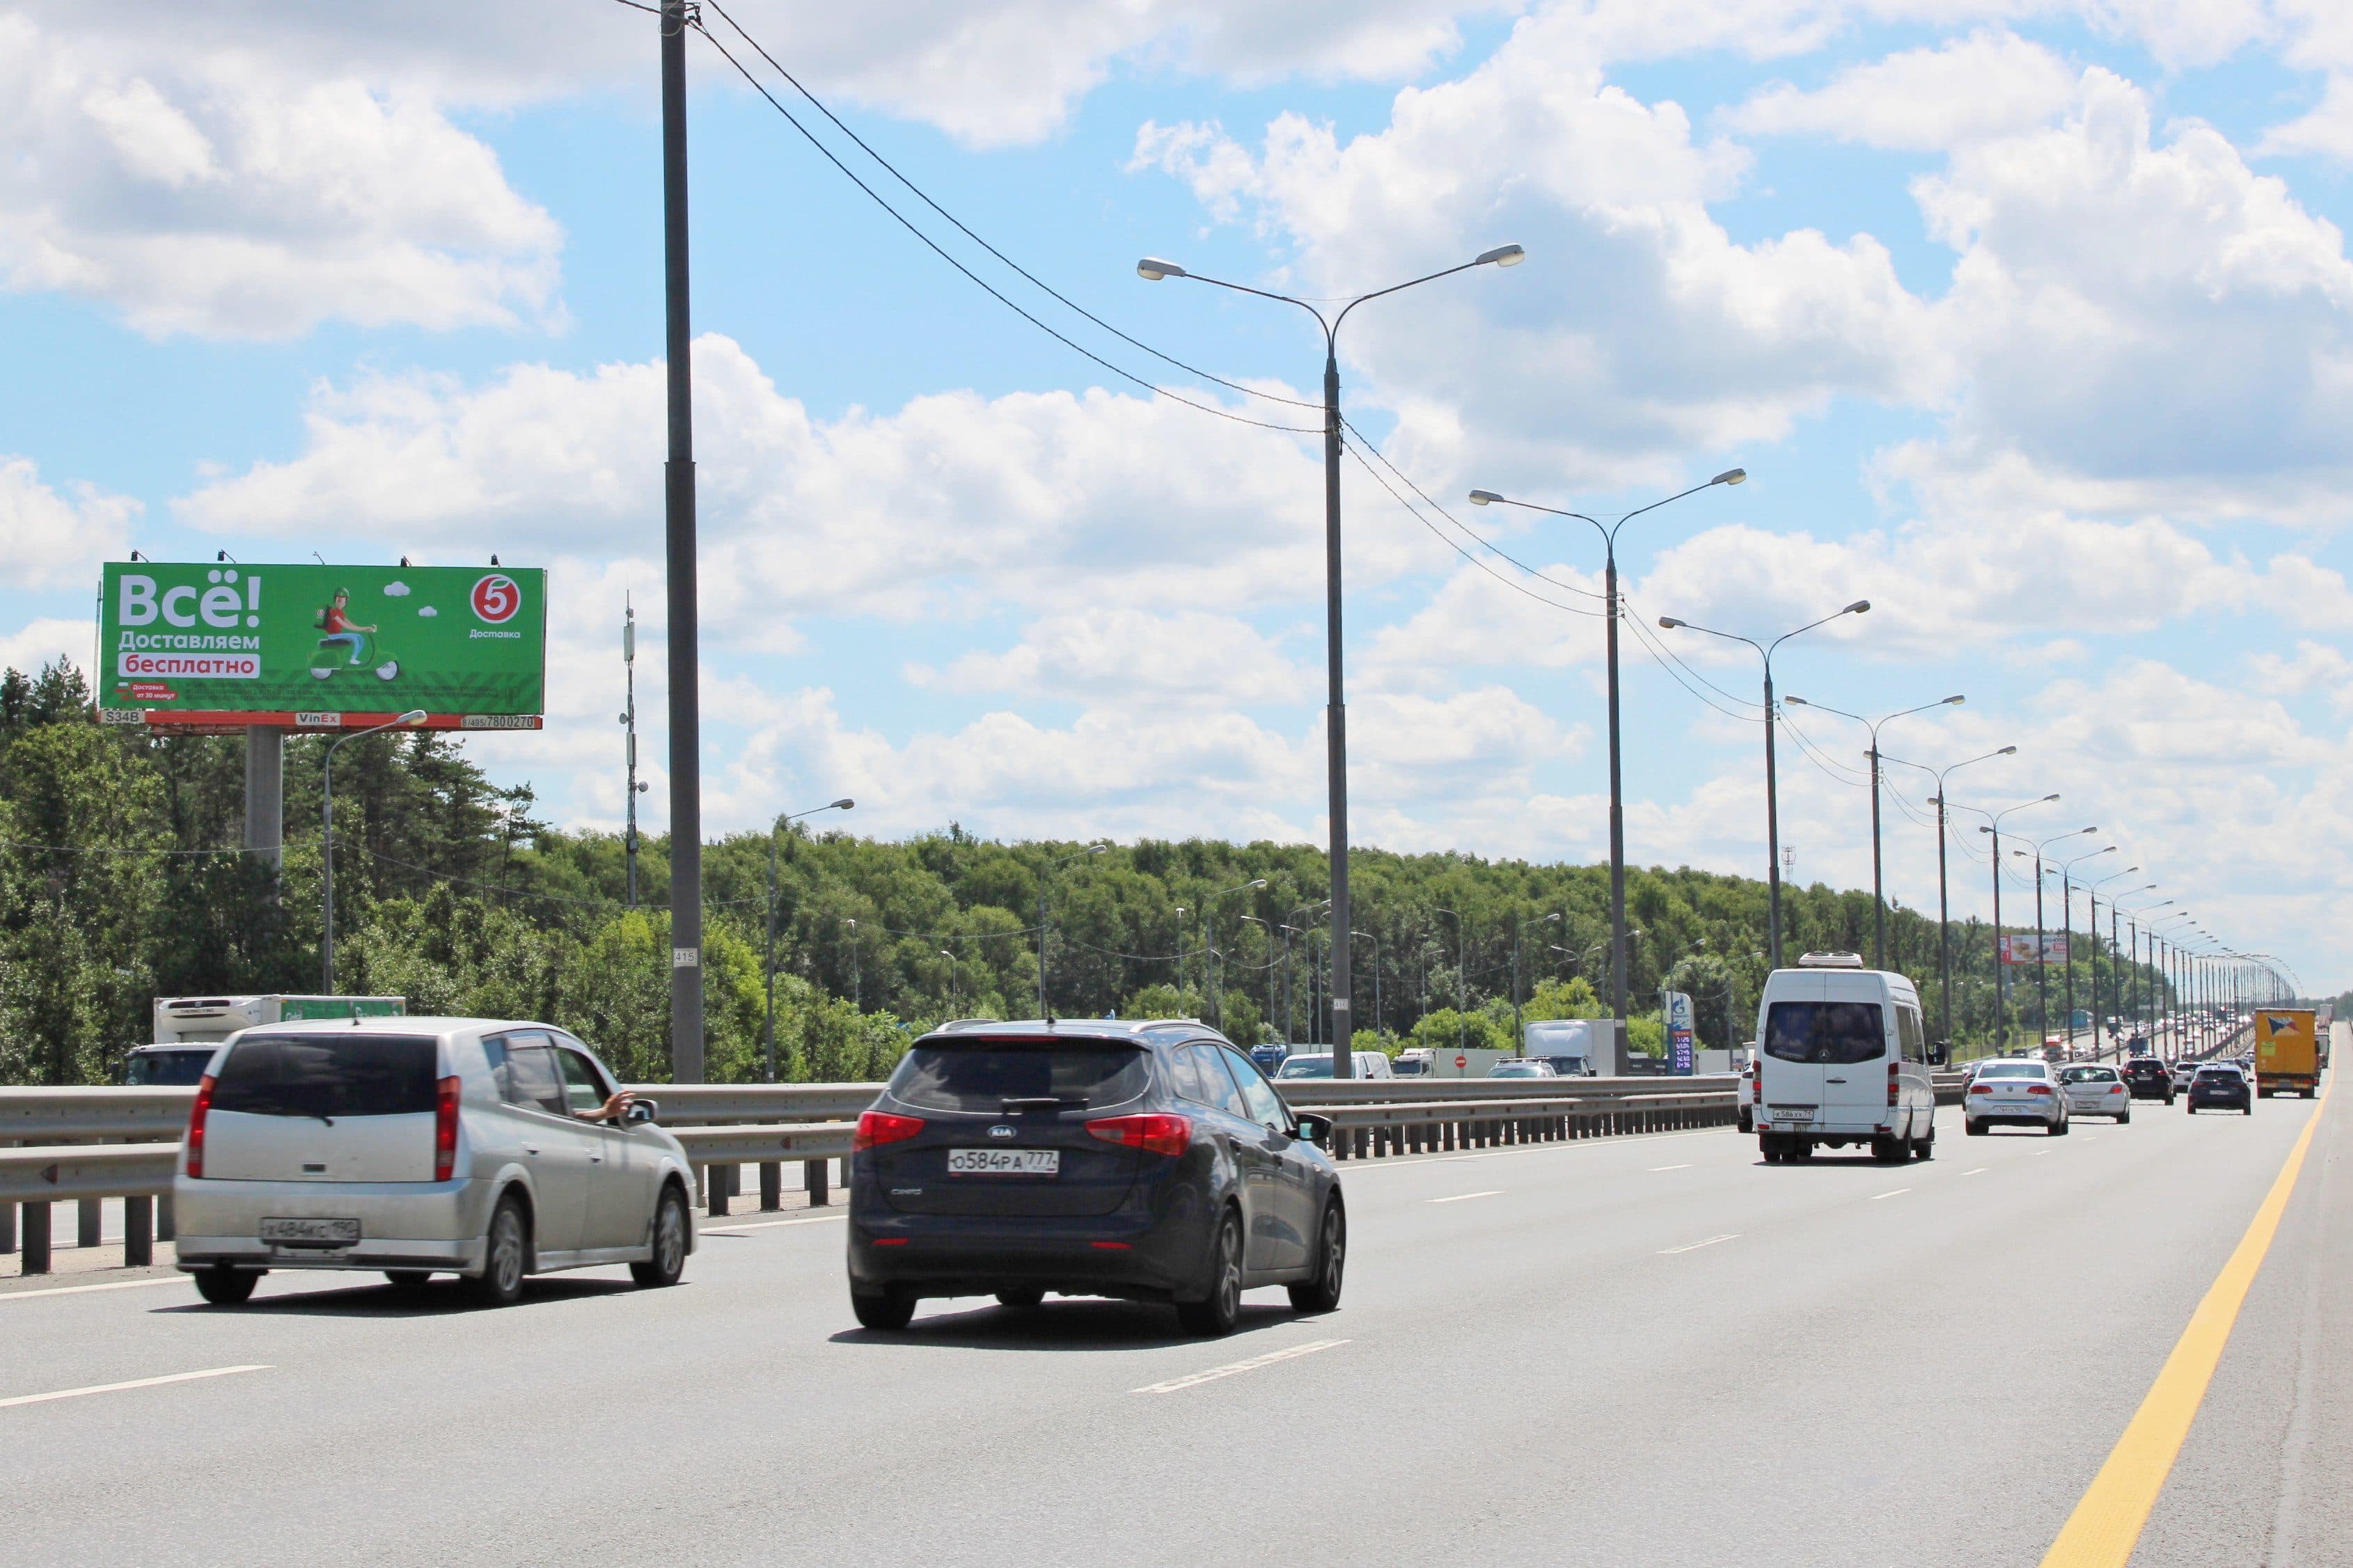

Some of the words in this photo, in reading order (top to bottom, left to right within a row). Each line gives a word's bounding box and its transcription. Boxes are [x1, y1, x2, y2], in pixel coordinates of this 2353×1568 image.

[119, 569, 261, 628] Всё!
[469, 629, 521, 639] Доставка
[118, 631, 260, 651] Доставляем
[125, 654, 255, 674] бесплатно
[106, 711, 139, 722] S34B
[299, 713, 336, 722] VinEx
[991, 1127, 1012, 1137] KIA
